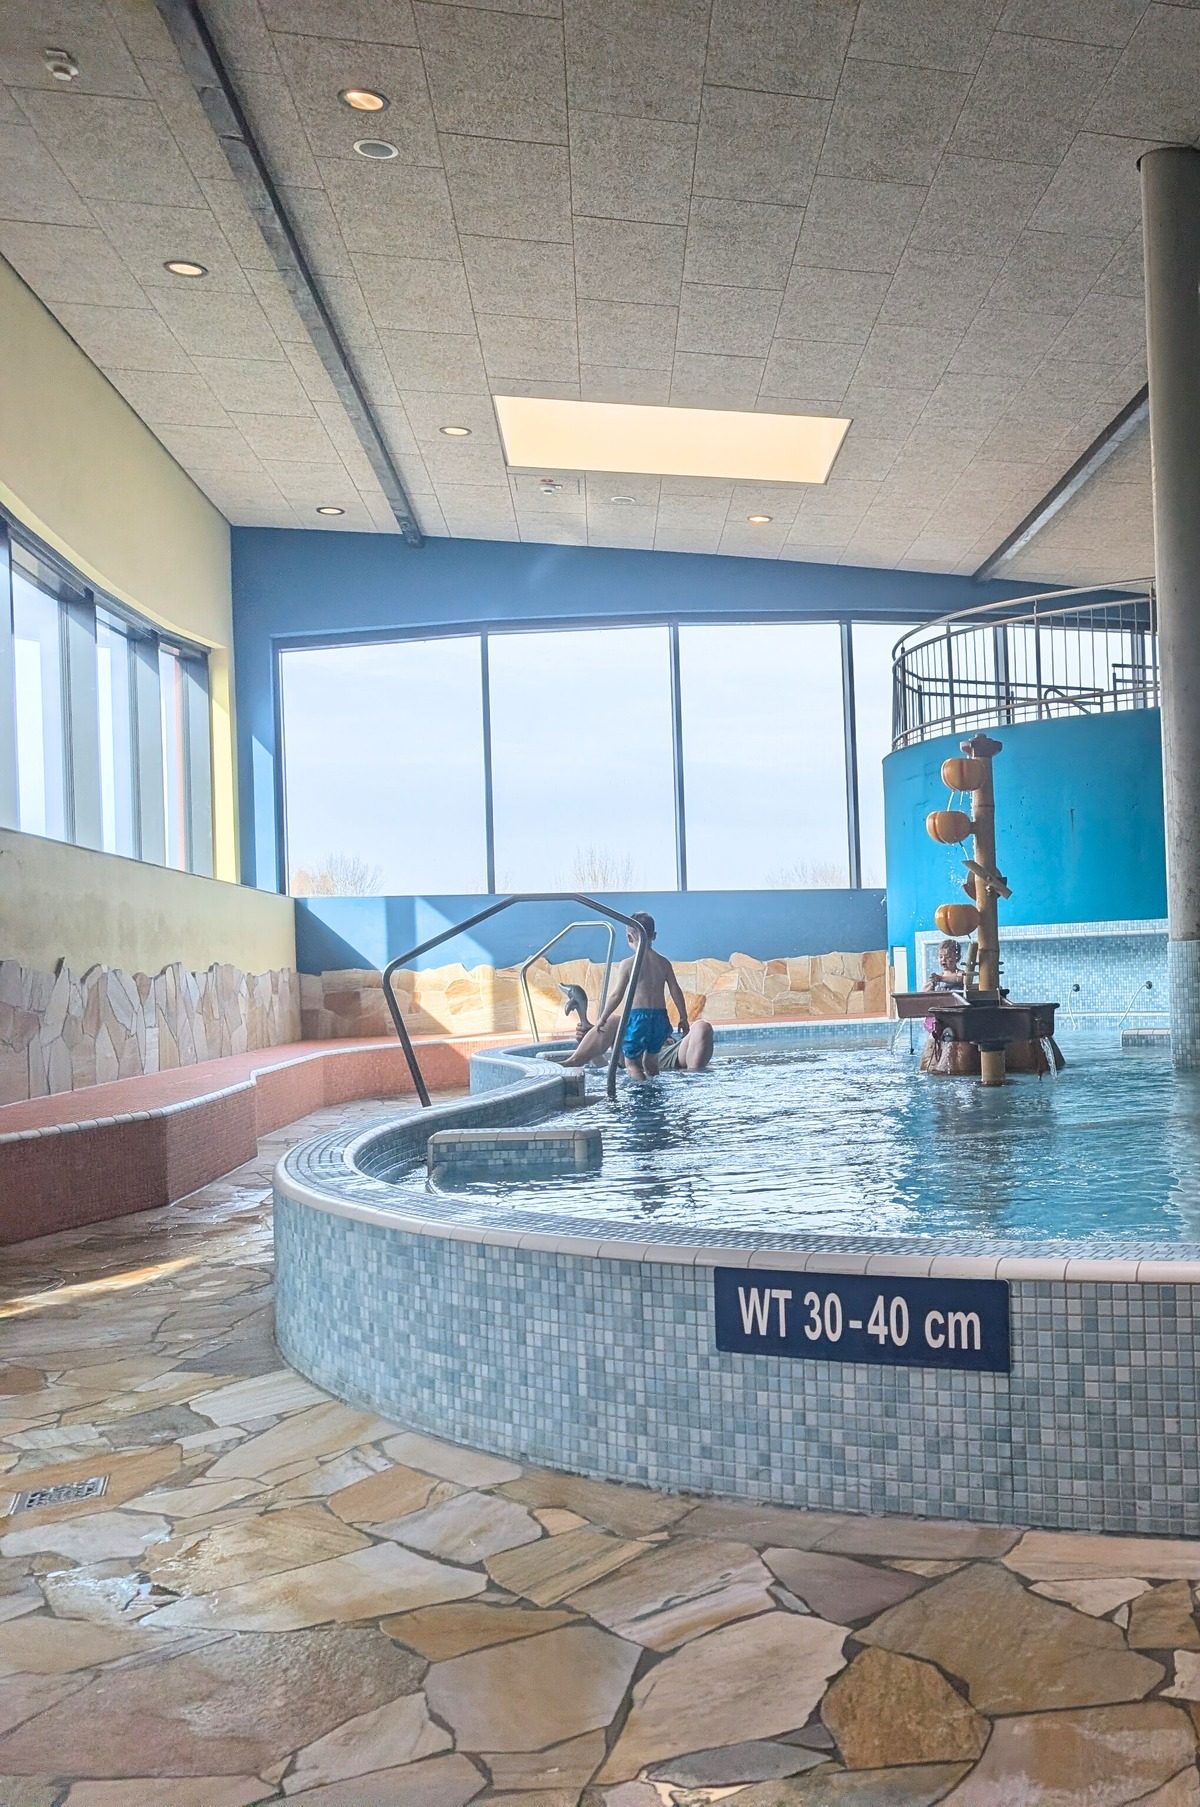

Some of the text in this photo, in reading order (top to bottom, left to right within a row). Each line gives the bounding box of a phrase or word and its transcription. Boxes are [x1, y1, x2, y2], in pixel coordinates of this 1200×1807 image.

[738, 1286, 981, 1350] WT 30-40 cm
